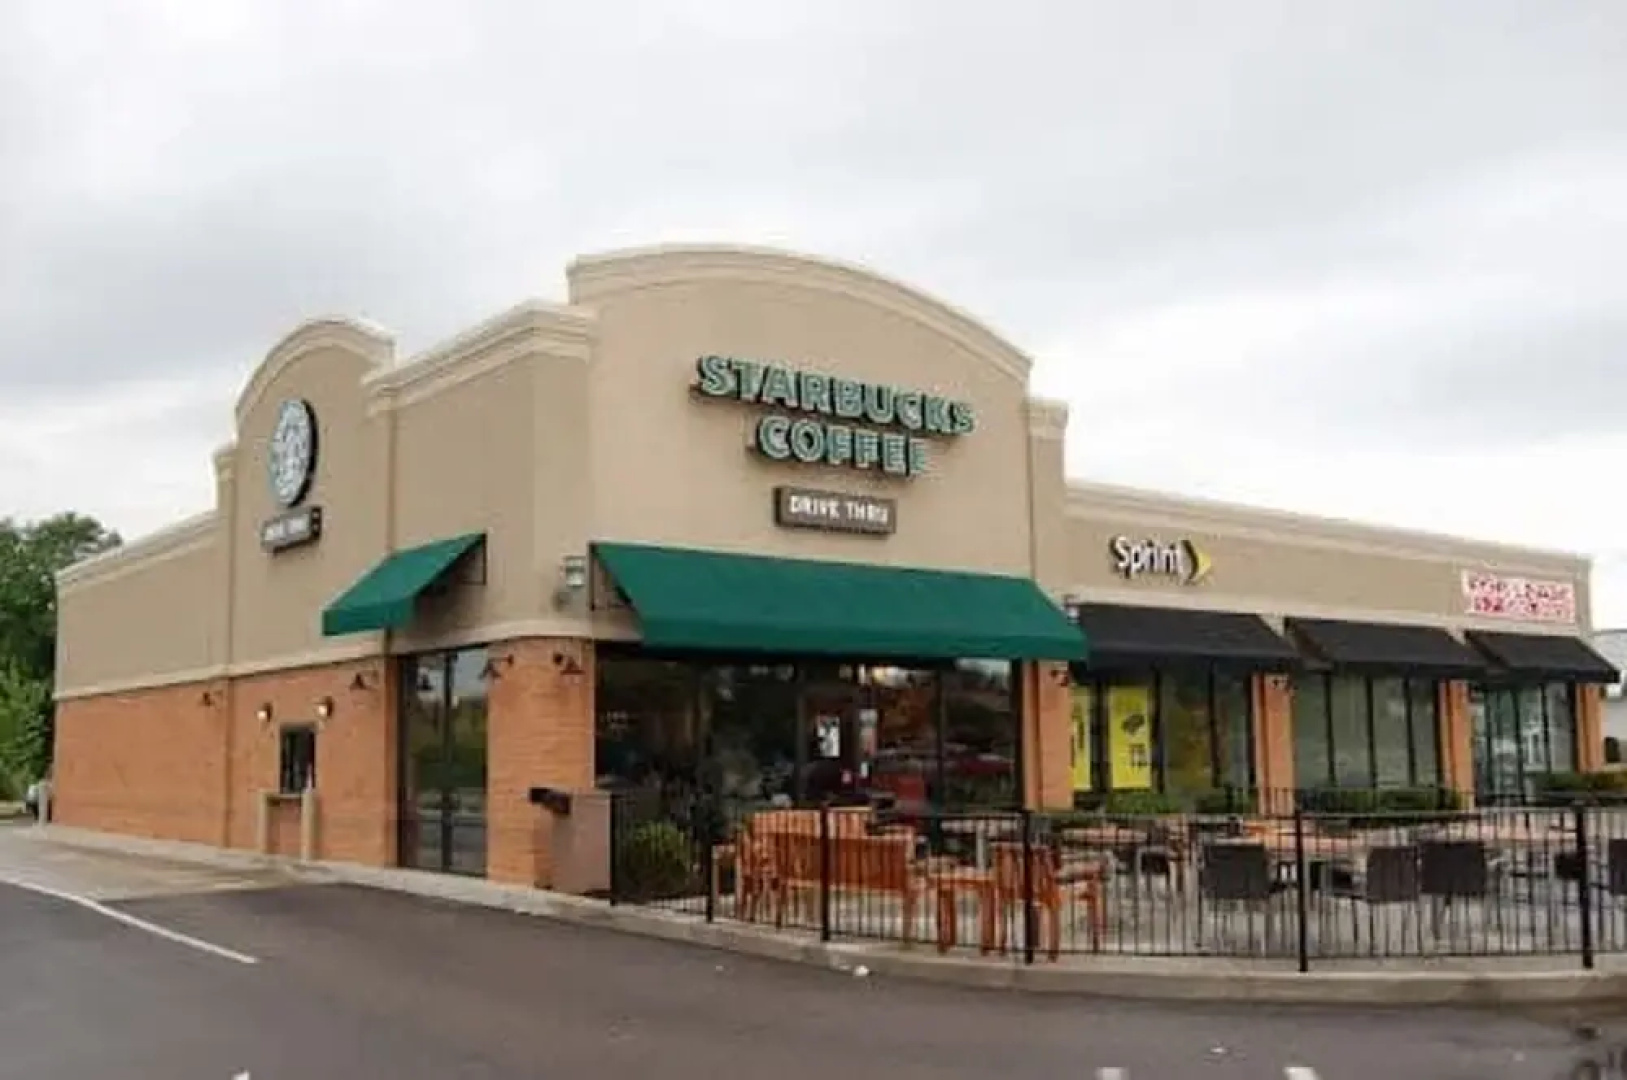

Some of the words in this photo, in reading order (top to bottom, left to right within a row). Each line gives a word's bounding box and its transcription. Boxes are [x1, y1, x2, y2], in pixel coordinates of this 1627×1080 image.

[697, 355, 976, 435] STARBUCKS
[757, 414, 927, 475] COFFEE
[790, 495, 840, 519] DRIVE
[1110, 535, 1184, 579] Sprint
